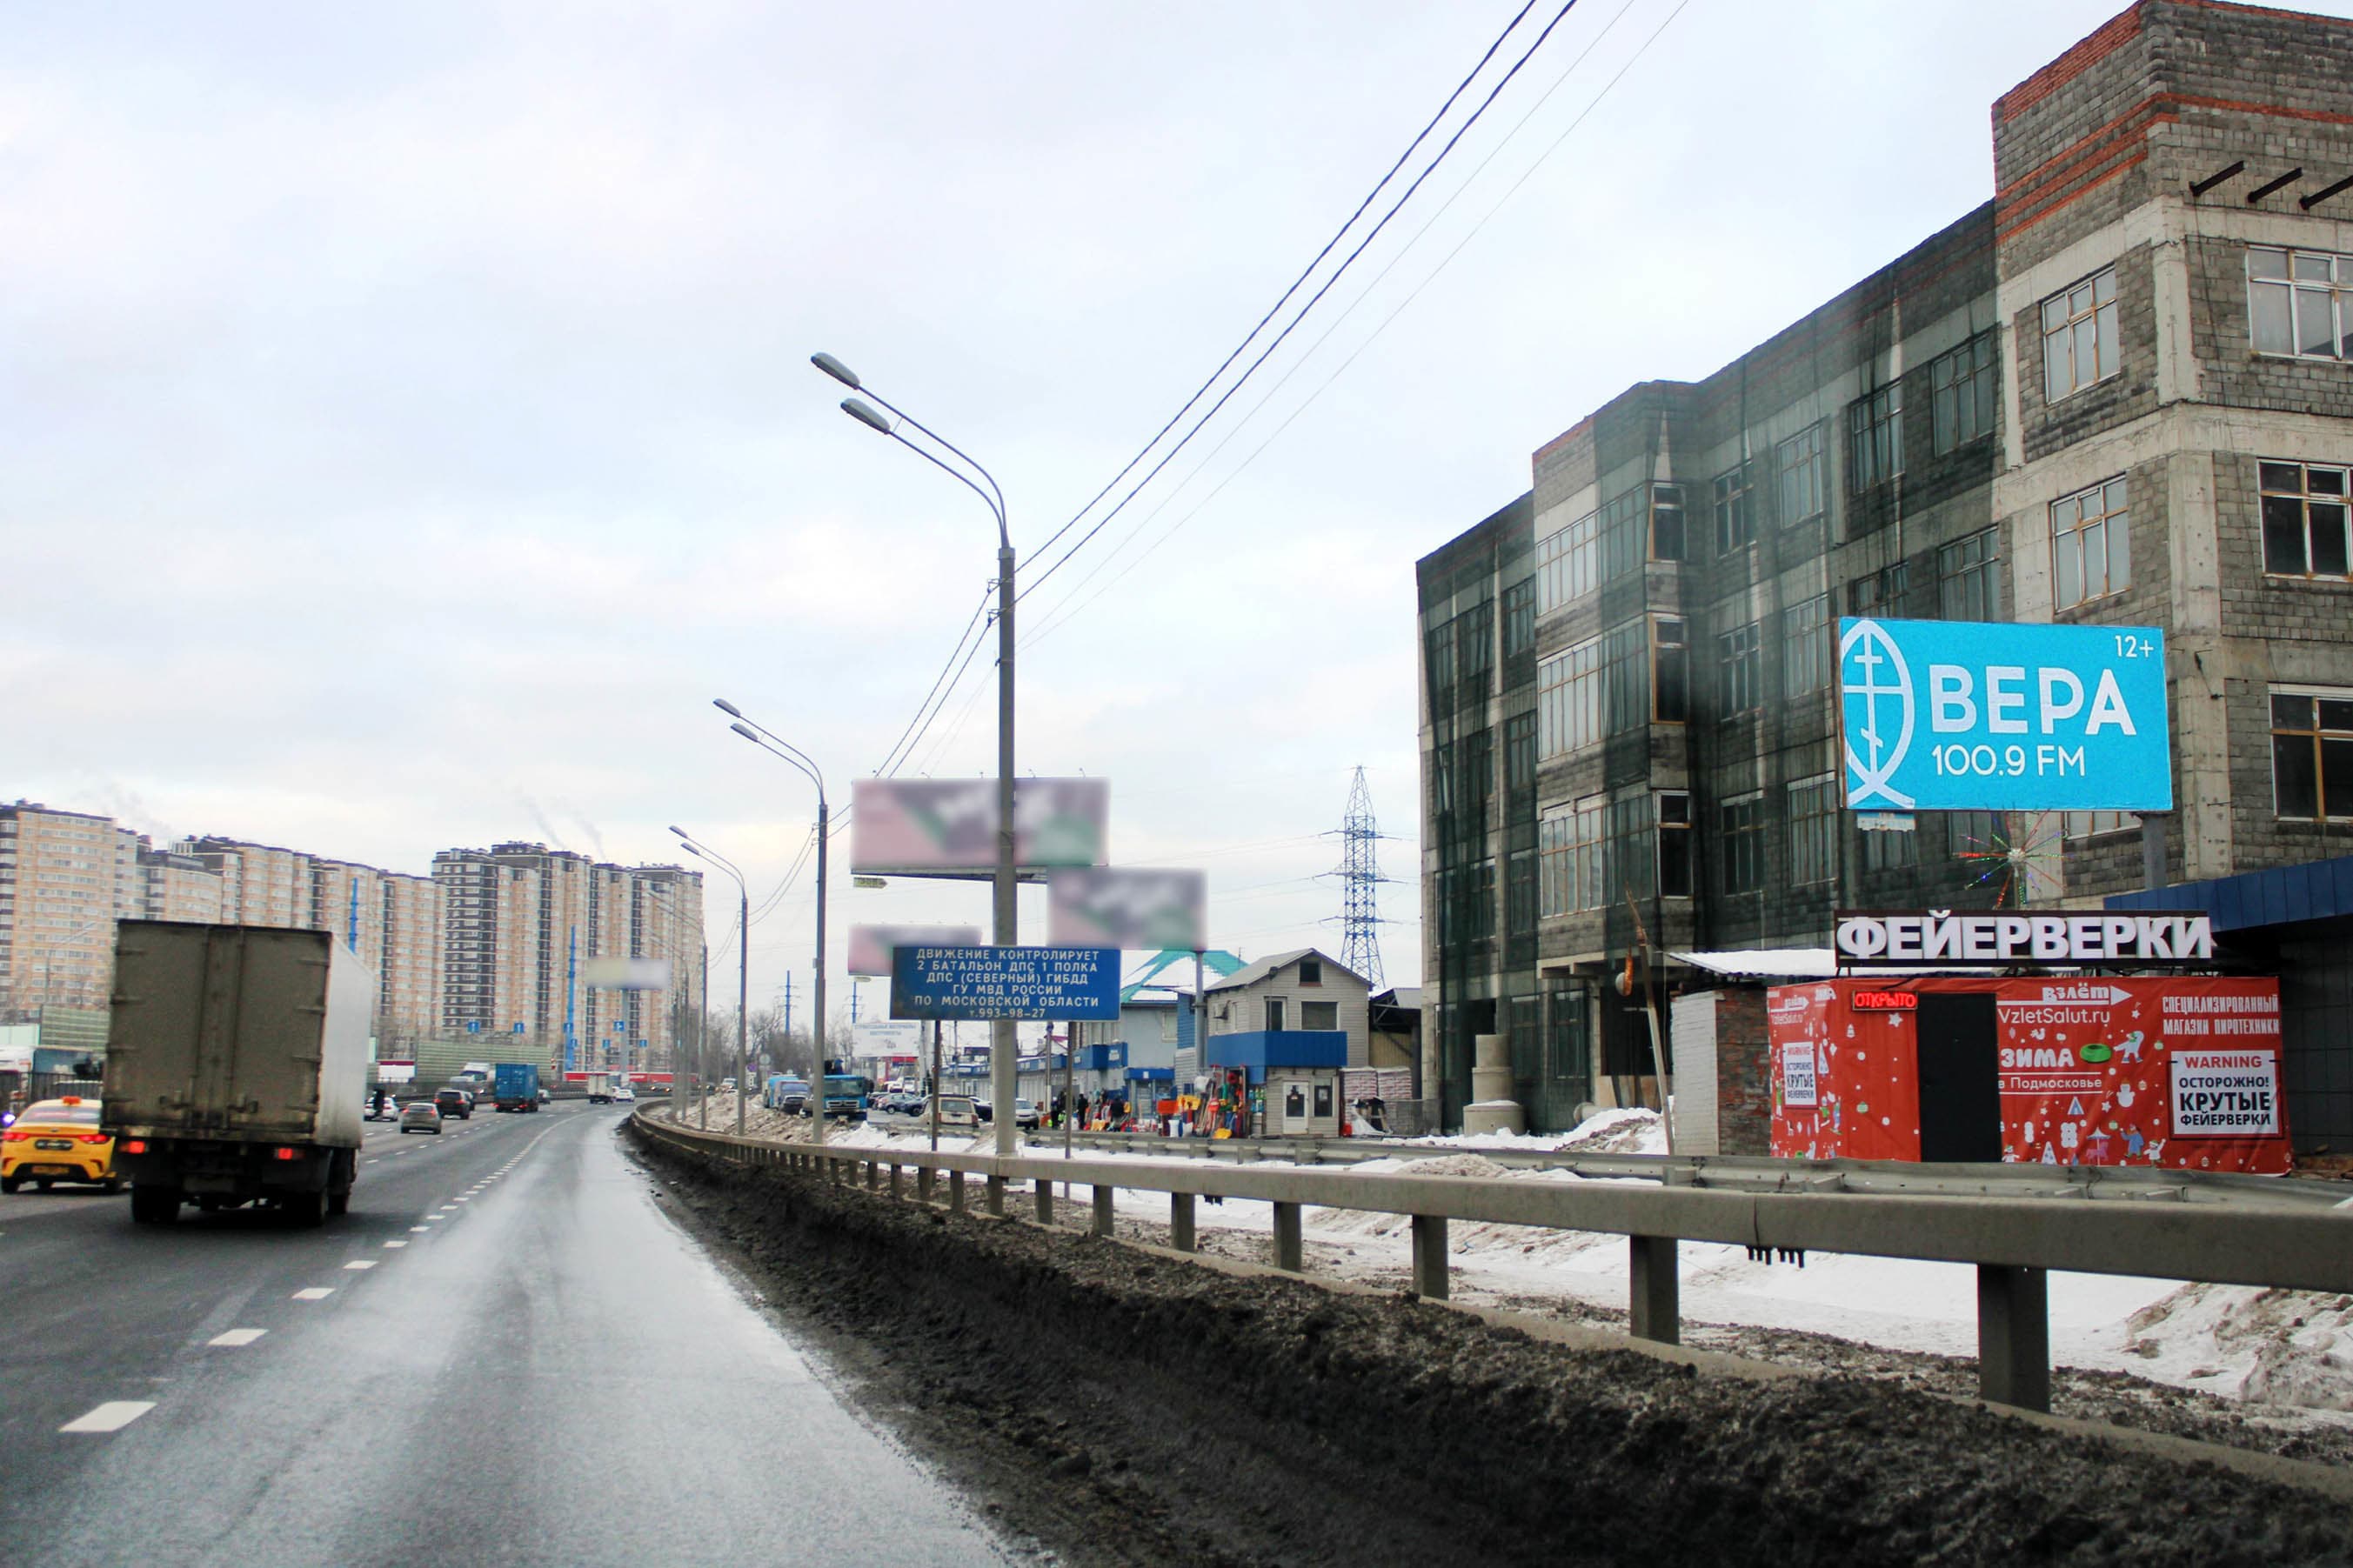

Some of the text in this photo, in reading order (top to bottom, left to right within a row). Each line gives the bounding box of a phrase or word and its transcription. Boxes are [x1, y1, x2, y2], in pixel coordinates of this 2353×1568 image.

[2115, 635, 2155, 658] 12+
[1929, 664, 2137, 736] ВЕРА
[1931, 744, 2086, 777] 100.9 FM
[1836, 909, 2212, 960] ФЕЙЕРВЕРКИ
[916, 948, 1100, 961] ДВИЖЕНИЕ КОНТРОЛИРУЕТ
[917, 960, 1098, 972] 2 БАТАЛЬОН ДПС 1 ПОЛКА
[926, 971, 1089, 984] ДПС (СЕВЕРНЫЙ) ГИБДД
[953, 984, 1062, 995] ГУ МВД РОССИИ
[914, 994, 1099, 1007] ПО МОСКОВСКОЙ ОБЛАСТИ
[1854, 992, 1917, 1008] ОТКРЫТО
[2162, 994, 2279, 1015] СПЕЦИАЛИЗИРОВАННЫЙ
[1997, 1007, 2110, 1024] VzletSalut.ru
[2162, 1018, 2280, 1035] МАГАЗИН ПИРОТЕХНИКИ
[2000, 1048, 2075, 1068] ЗИМА
[2184, 1055, 2263, 1069] WARNING
[1997, 1077, 2102, 1091] в Подмосковье
[2178, 1076, 2269, 1089] ОСТОРОЖНО!
[2179, 1091, 2270, 1111] КРУТЫЕ
[2180, 1111, 2271, 1126] ФЕЙЕРВЕРКИ
